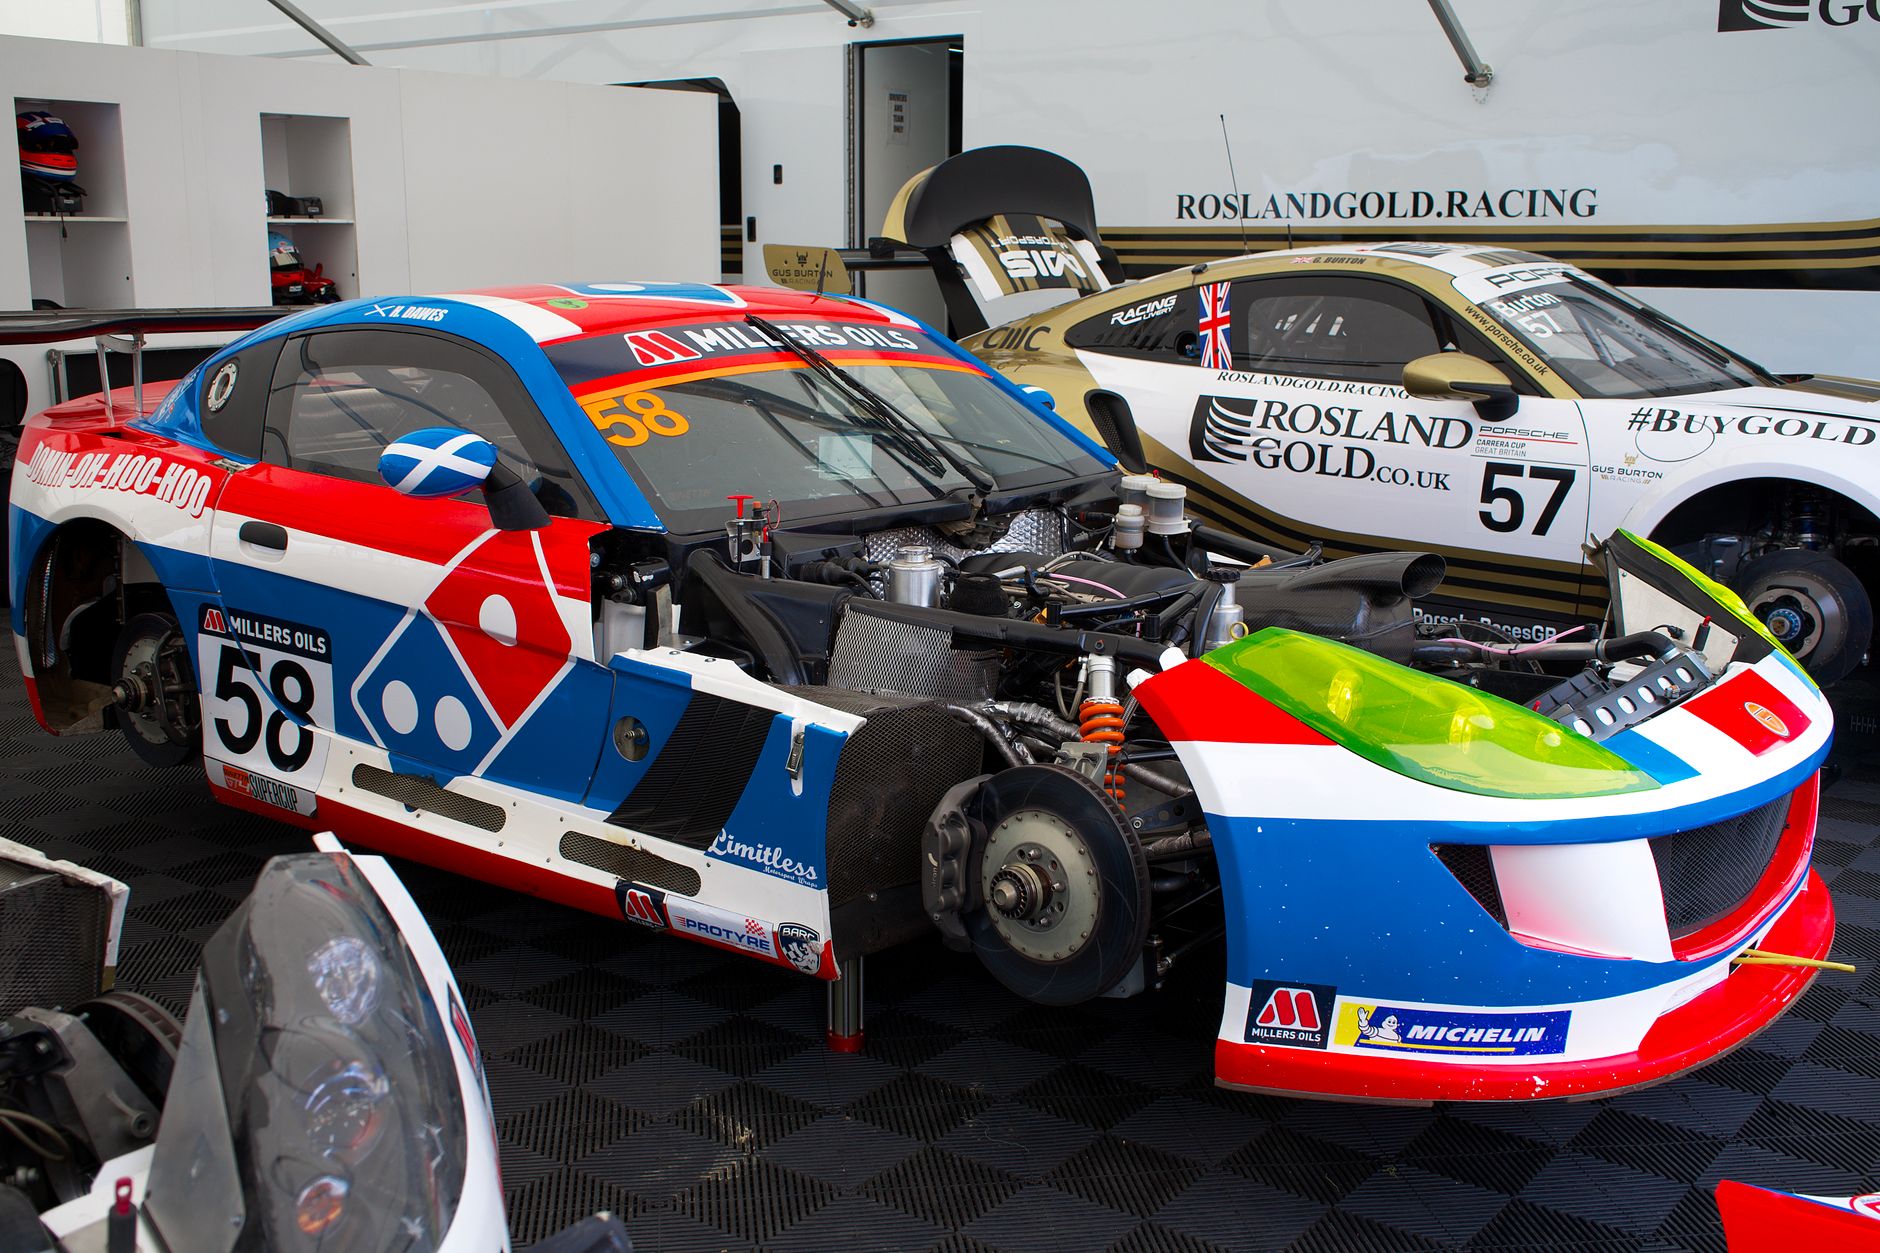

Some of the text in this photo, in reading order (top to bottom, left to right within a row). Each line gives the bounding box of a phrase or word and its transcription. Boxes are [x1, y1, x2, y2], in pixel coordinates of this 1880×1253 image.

[1175, 188, 1599, 220] ROSLANDGOLD.RACING
[772, 269, 833, 278] GUS BURTN
[1323, 256, 1367, 265] BURTON
[401, 306, 448, 322] DAWES
[1110, 295, 1178, 326] RACING
[1142, 306, 1174, 320] LIVERY
[1489, 292, 1563, 319] Burton
[842, 326, 918, 350] OILS
[1517, 310, 1563, 338] 57
[1465, 305, 1549, 376] www.porsche.co.uk
[1217, 371, 1410, 400] ROSLANDGOLD.RACING
[580, 391, 690, 447] 58
[1256, 400, 1474, 450] ROSLAND
[1479, 425, 1570, 440] PORSCHE
[1627, 406, 1877, 446] #BUYGOLD
[1476, 439, 1509, 447] CARRERA
[1498, 449, 1526, 457] BRITAIN
[1252, 437, 1451, 491] GOLD.CO.UK
[1592, 465, 1664, 479] GUS BURTON
[27, 440, 213, 518] DOMIN-OH-HOO-HOO
[1610, 475, 1642, 484] RACING
[1478, 461, 1576, 537] 57
[228, 616, 326, 654] MILLERS OILS
[214, 644, 318, 773] 58
[248, 773, 298, 812] SUPERCUP
[707, 828, 818, 880] Limitless
[763, 866, 818, 888] Motorsport Wraps
[686, 917, 770, 951] PROTYRE
[1251, 1027, 1321, 1043] MILLERS OILS
[1406, 1024, 1547, 1043] MICHELIN
